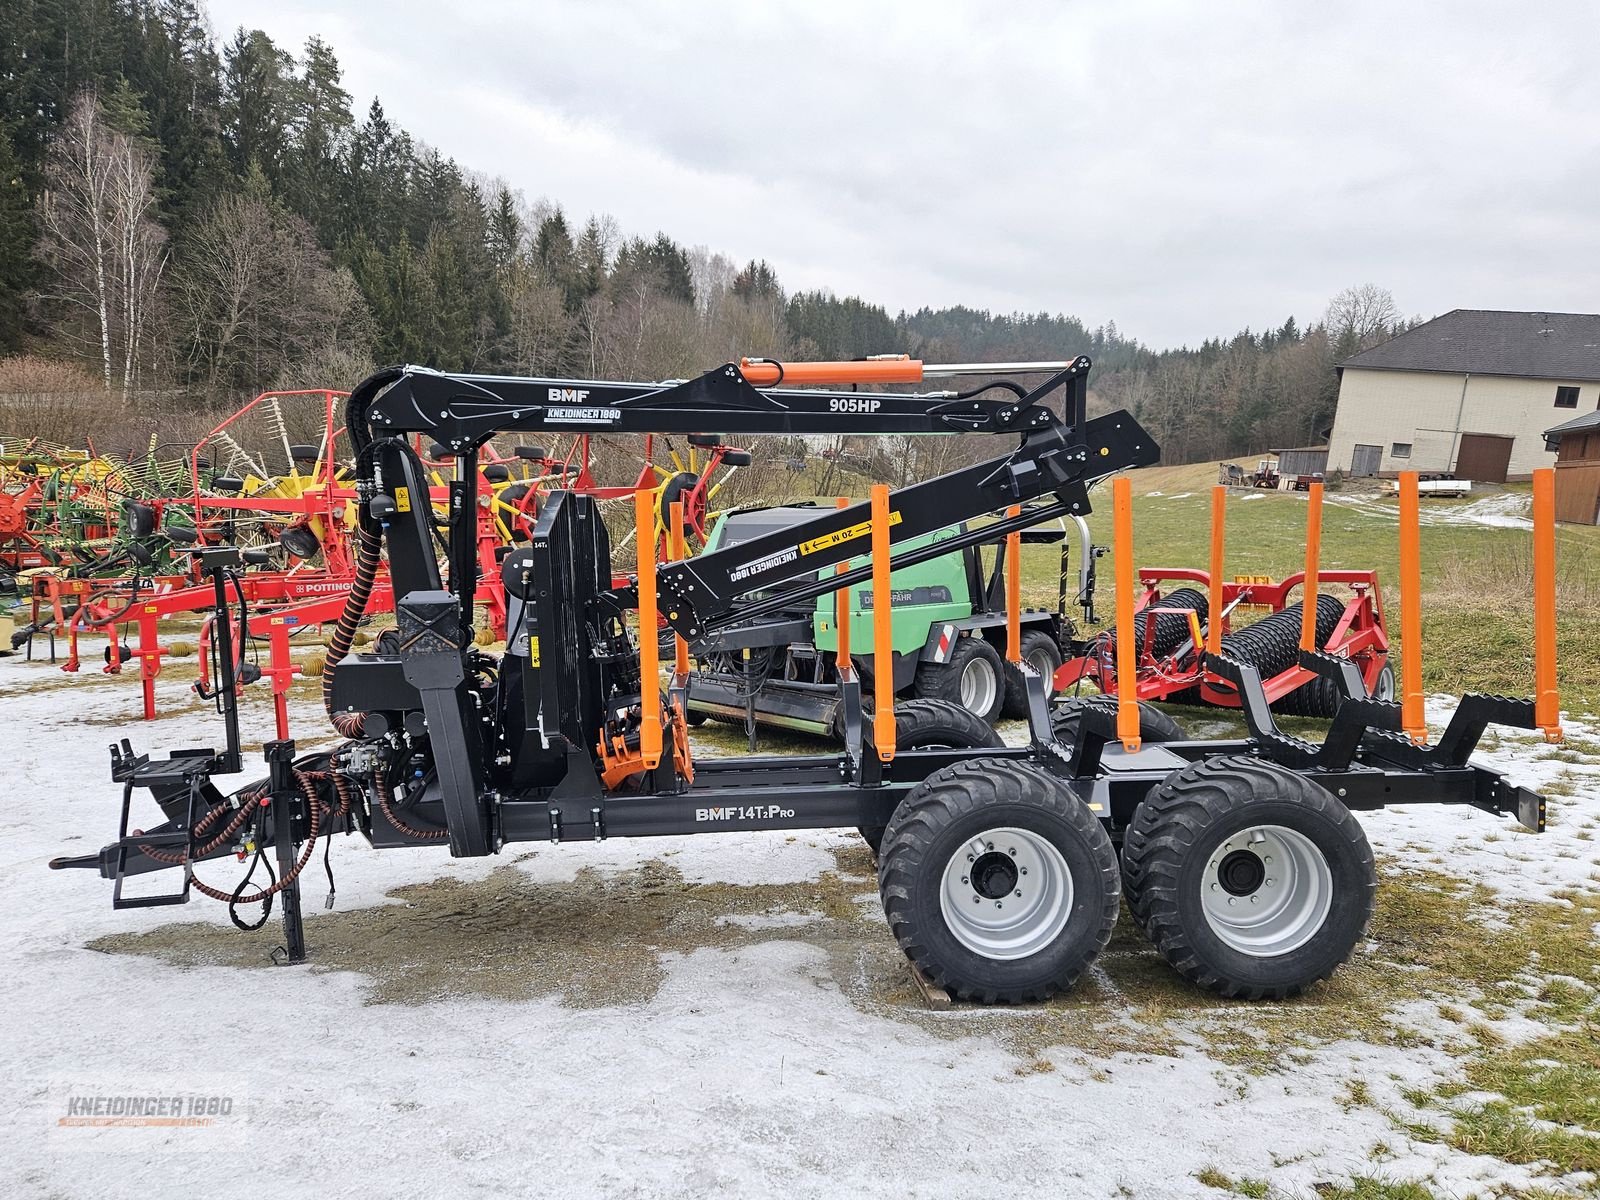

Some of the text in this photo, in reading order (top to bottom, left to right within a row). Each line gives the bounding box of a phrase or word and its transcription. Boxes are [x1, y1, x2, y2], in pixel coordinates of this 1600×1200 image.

[548, 388, 590, 403] BMF
[829, 398, 881, 413] 905HP
[547, 408, 621, 419] KNEIDINGER 1880
[831, 529, 853, 543] 20 M
[750, 550, 798, 575] KNEIDINGER
[730, 568, 750, 582] 1880
